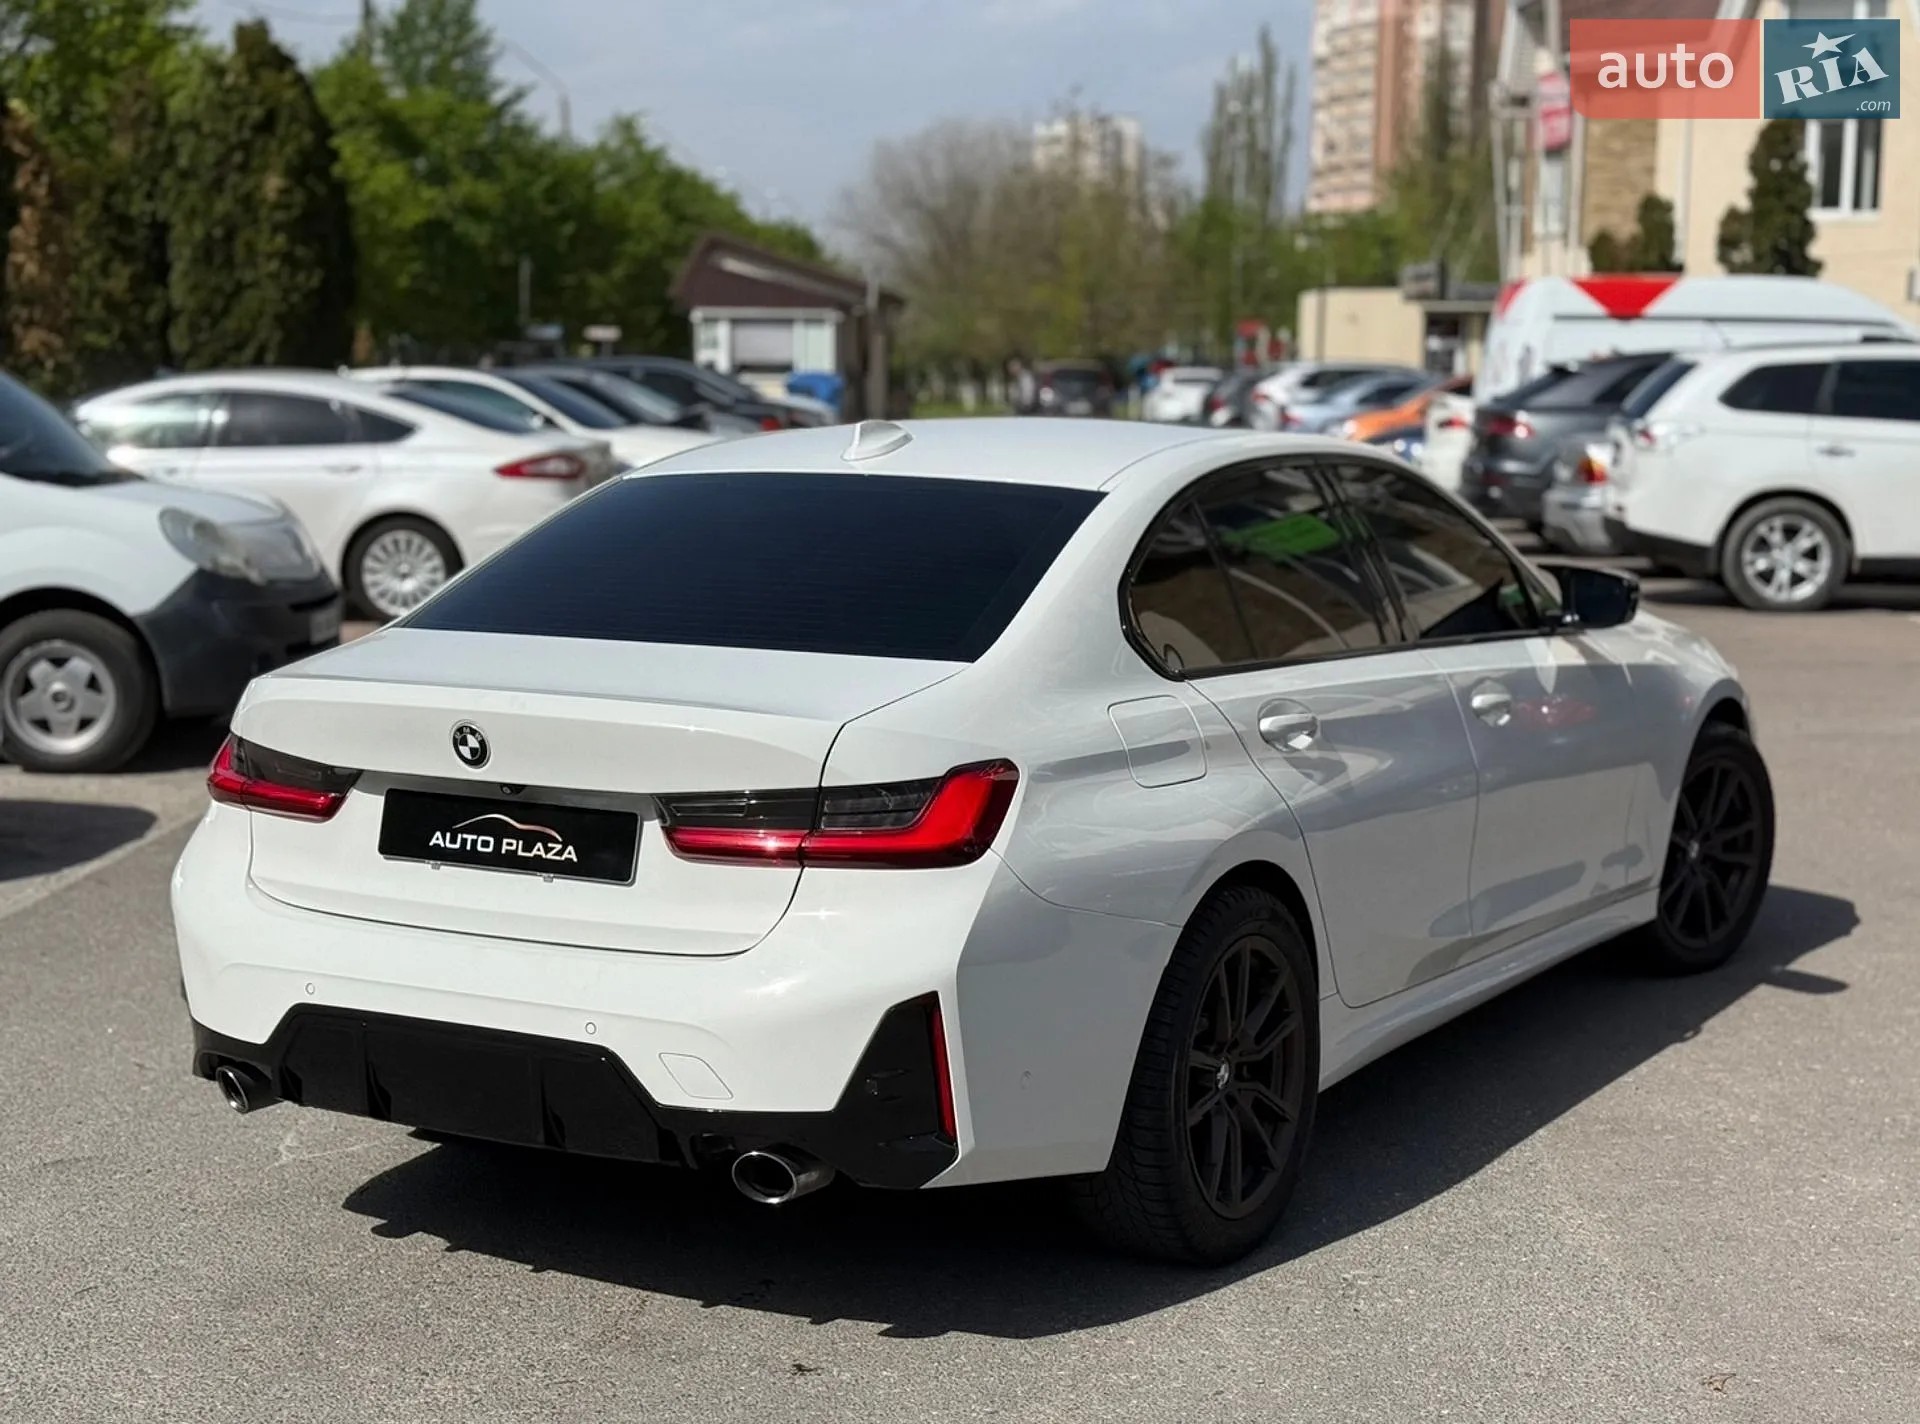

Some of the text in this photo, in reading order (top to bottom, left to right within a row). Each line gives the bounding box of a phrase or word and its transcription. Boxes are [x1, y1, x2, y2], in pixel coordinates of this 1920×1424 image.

[454, 727, 483, 741] BMW
[429, 831, 577, 862] AUTO PLAZA
